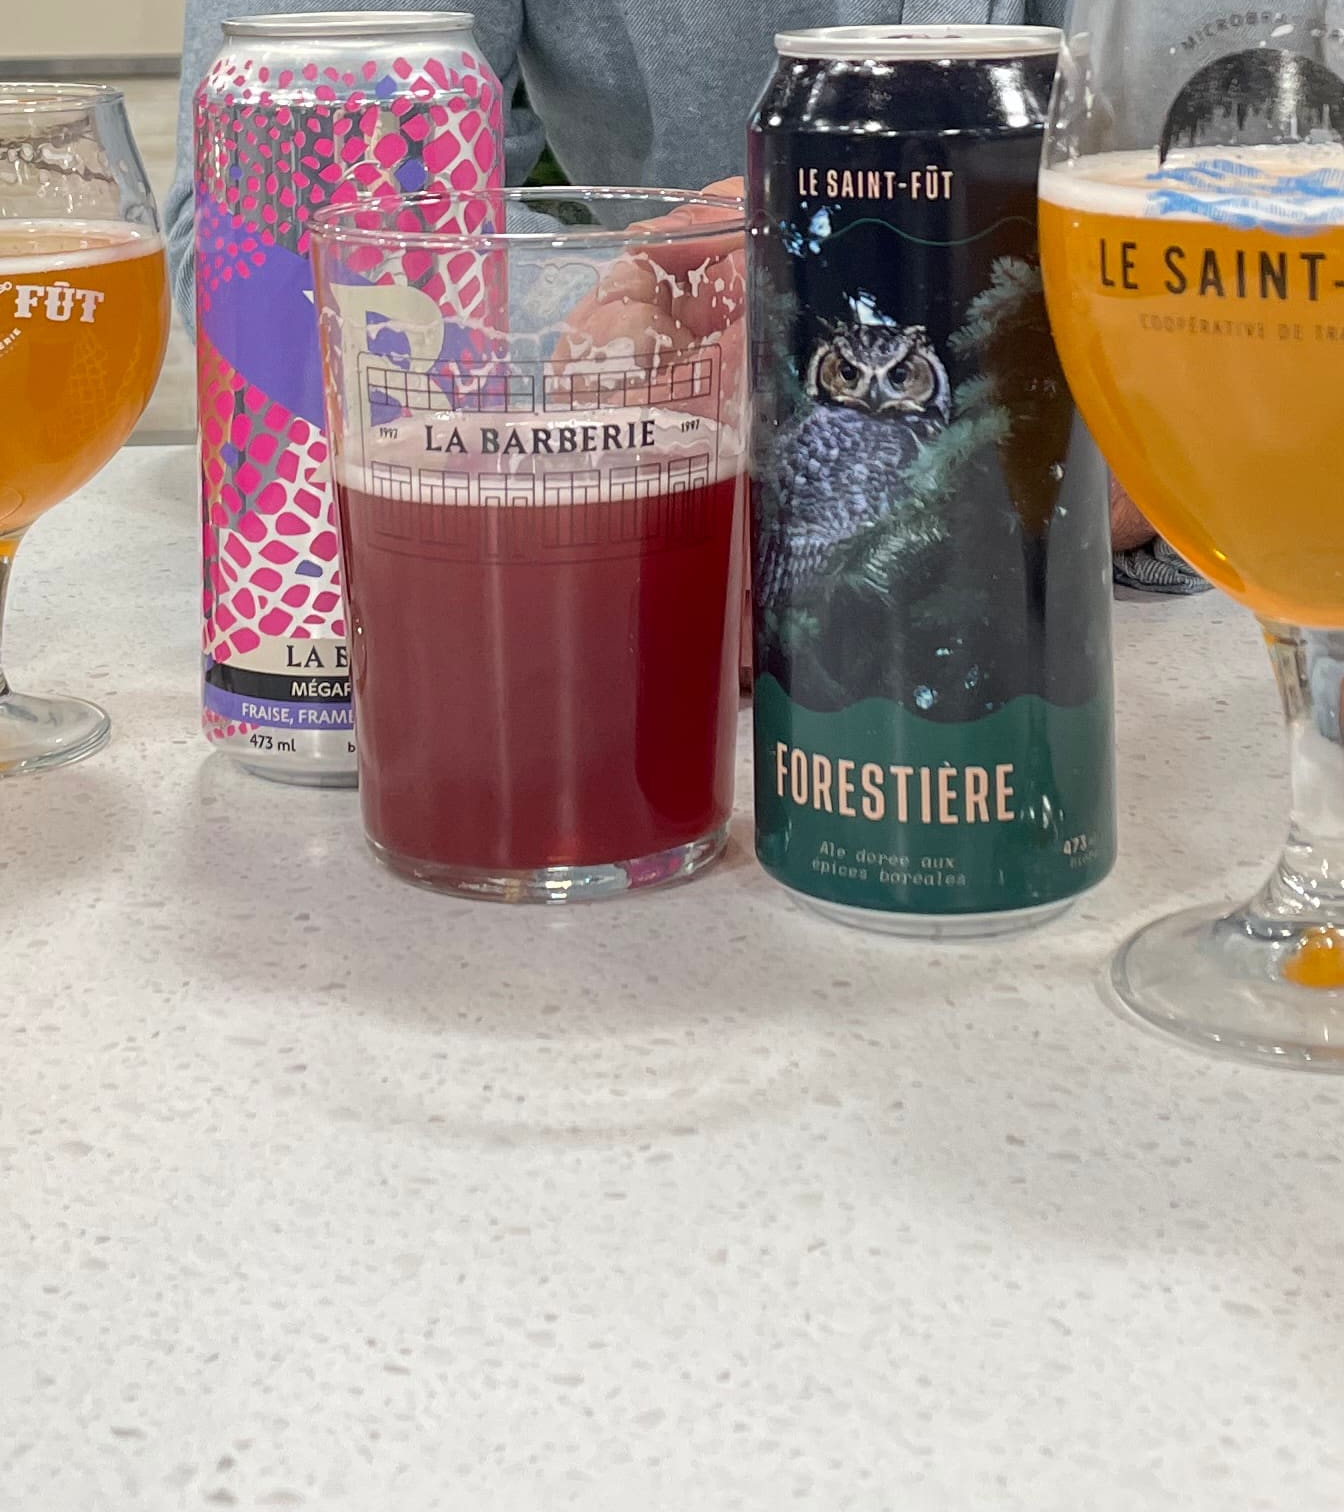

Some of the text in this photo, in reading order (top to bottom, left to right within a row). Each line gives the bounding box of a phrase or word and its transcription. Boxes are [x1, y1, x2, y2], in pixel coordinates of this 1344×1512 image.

[799, 167, 819, 197] LE
[1099, 238, 1140, 291] LE
[424, 424, 469, 454] LA
[479, 419, 656, 455] BARBERIE
[286, 644, 325, 668] LA
[241, 701, 295, 726] FRAISE,
[249, 733, 297, 753] 473 ml
[776, 740, 1016, 825] FORESTIÈRE
[819, 840, 846, 860] Ale
[921, 855, 955, 870] aux
